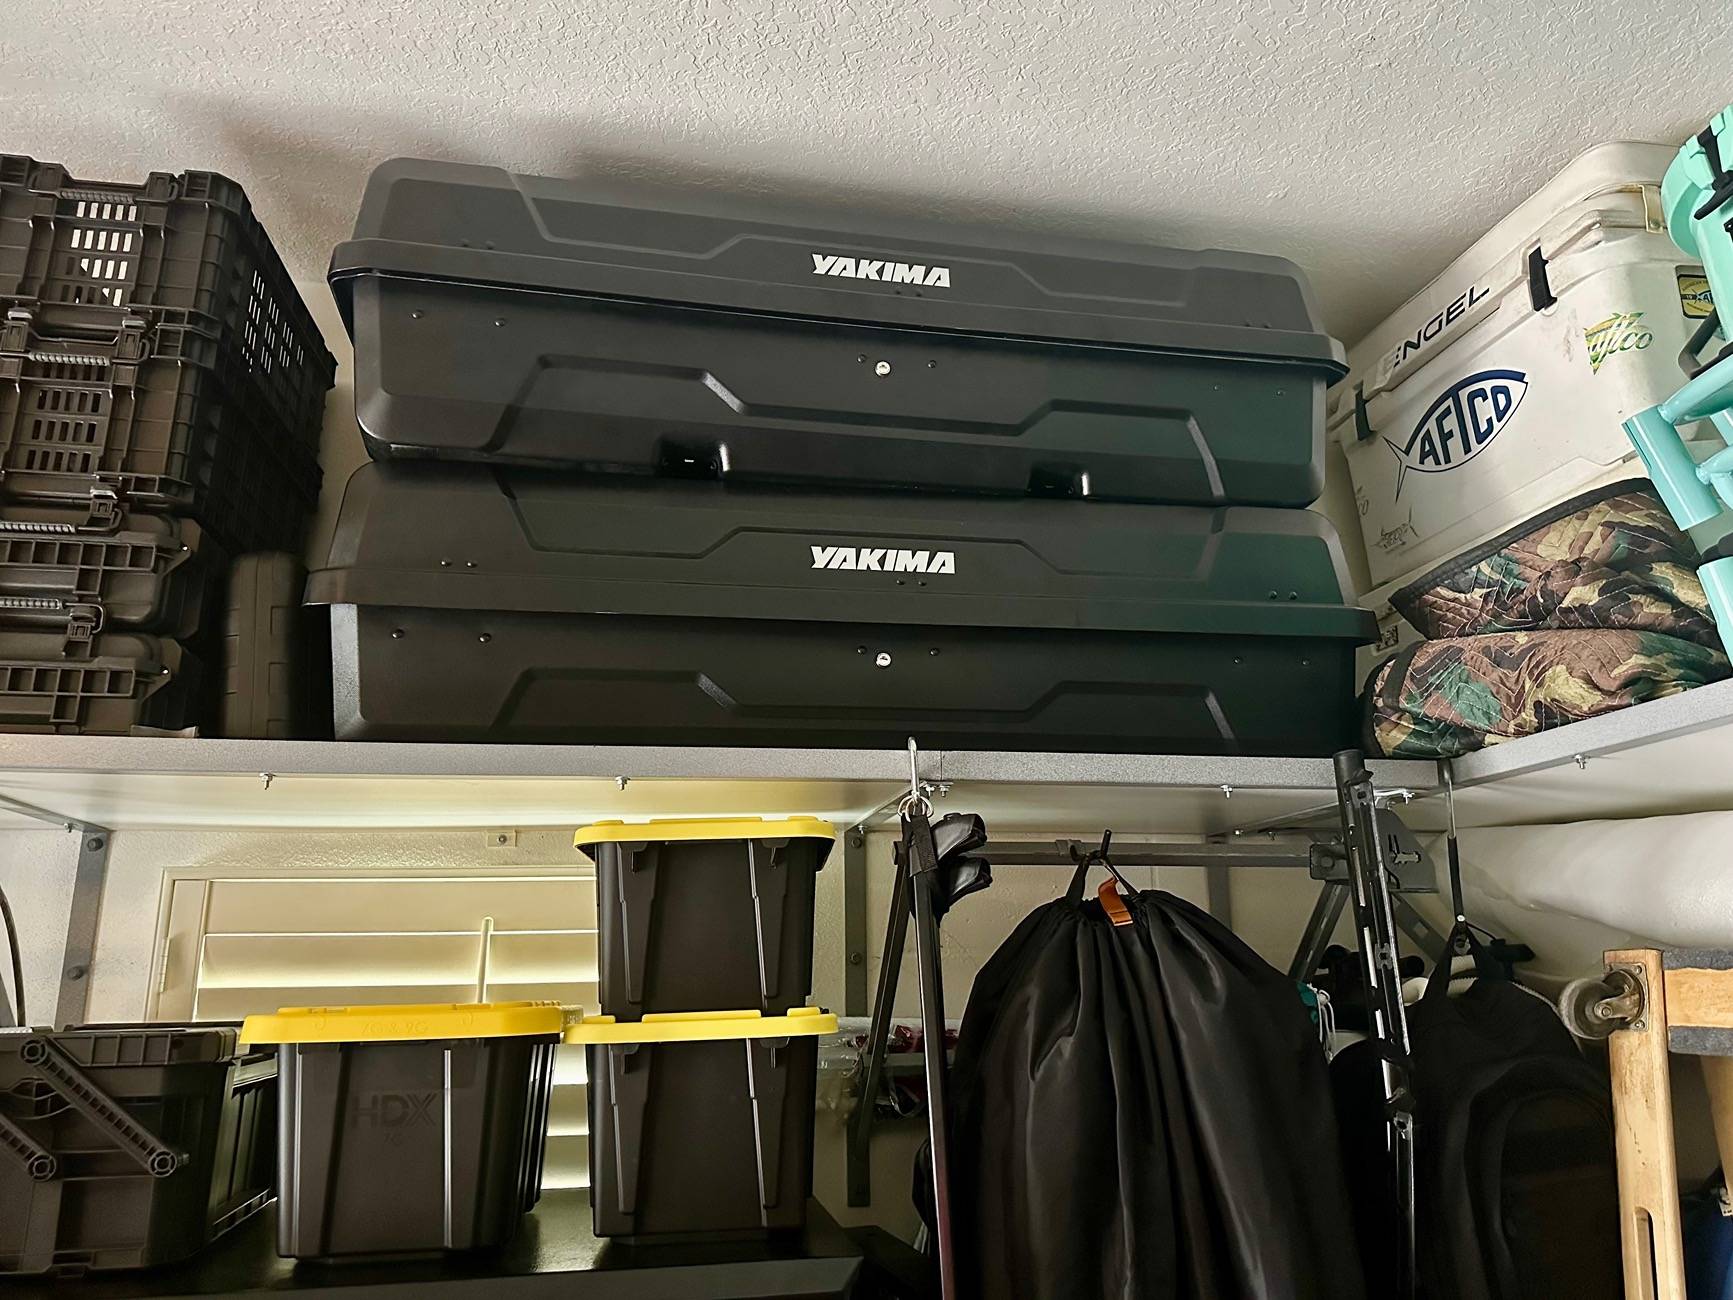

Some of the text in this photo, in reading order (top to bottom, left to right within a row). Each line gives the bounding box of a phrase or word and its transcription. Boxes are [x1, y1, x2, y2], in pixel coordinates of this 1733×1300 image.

[811, 253, 951, 288] YAKIMA
[1408, 369, 1525, 467] AFTCO
[810, 545, 956, 575] YAKIMA
[350, 1092, 438, 1128] HDX
